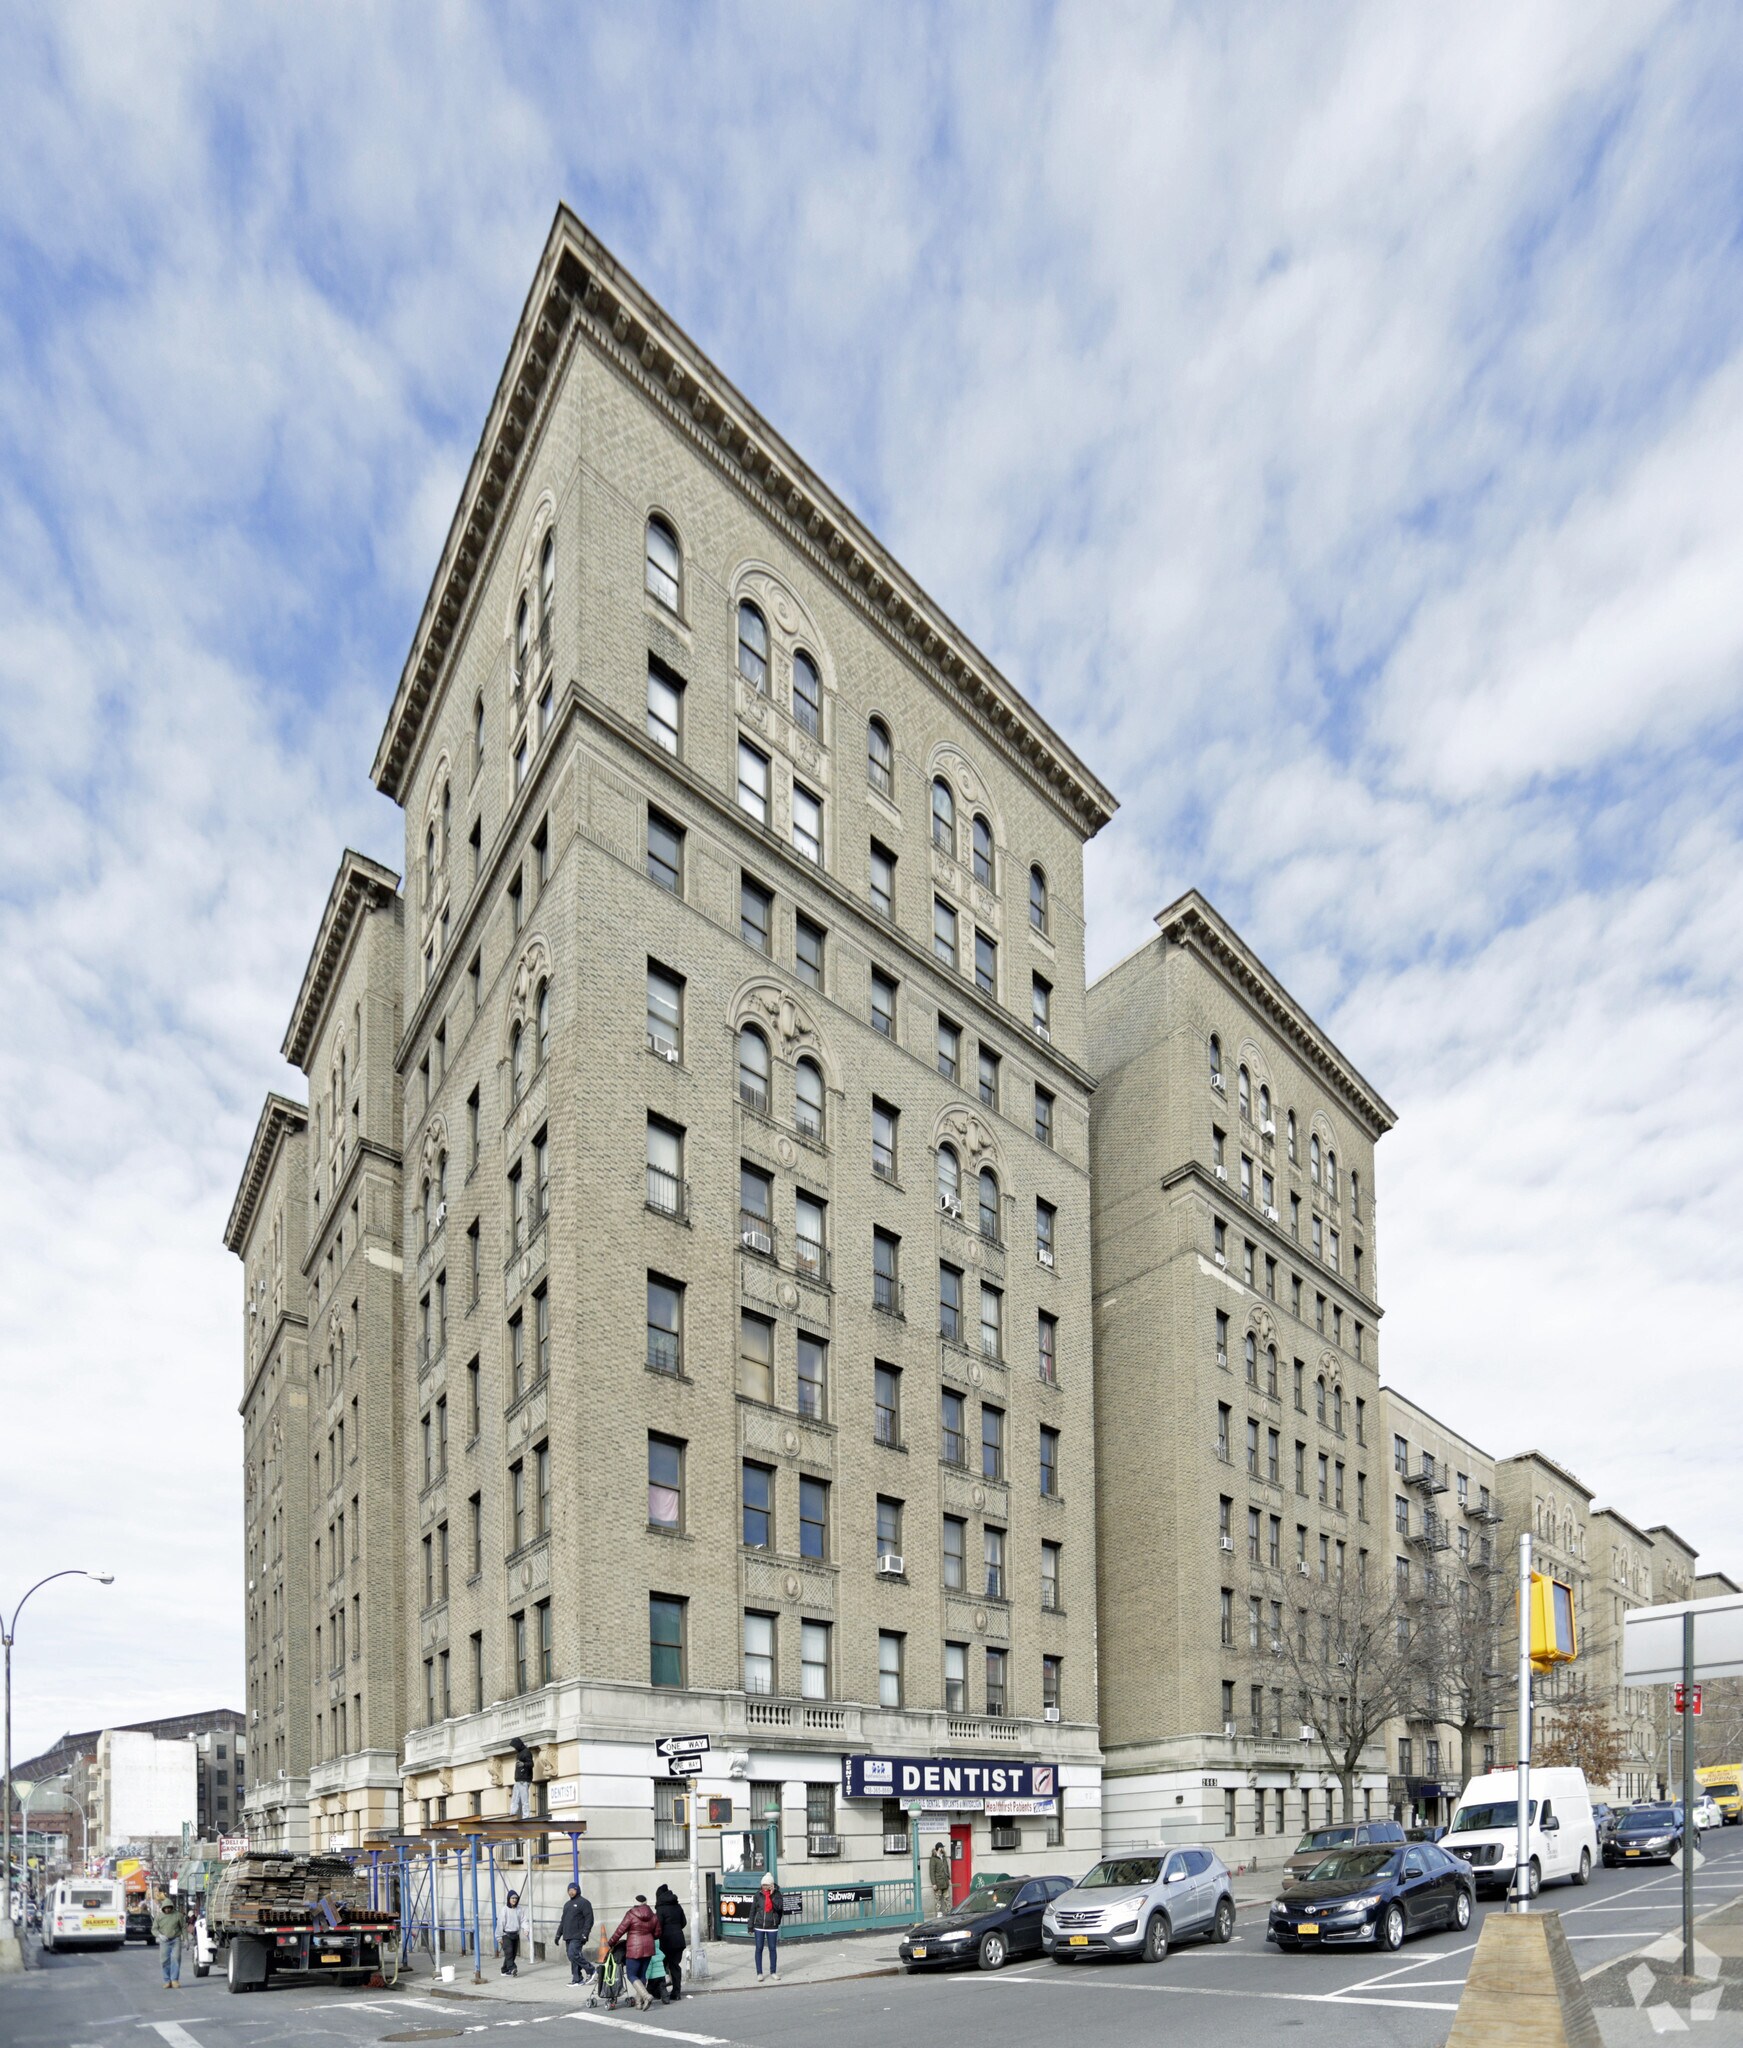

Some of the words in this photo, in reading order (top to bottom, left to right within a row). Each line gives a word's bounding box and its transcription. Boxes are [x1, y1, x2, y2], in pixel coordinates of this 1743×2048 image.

[666, 1743, 682, 1751] ONE
[688, 1740, 704, 1748] WAY
[674, 1762, 684, 1770] ONE
[902, 1765, 1024, 1793] DENTIST
[551, 1785, 573, 1799] DENTIST
[827, 1891, 856, 1901] Subway
